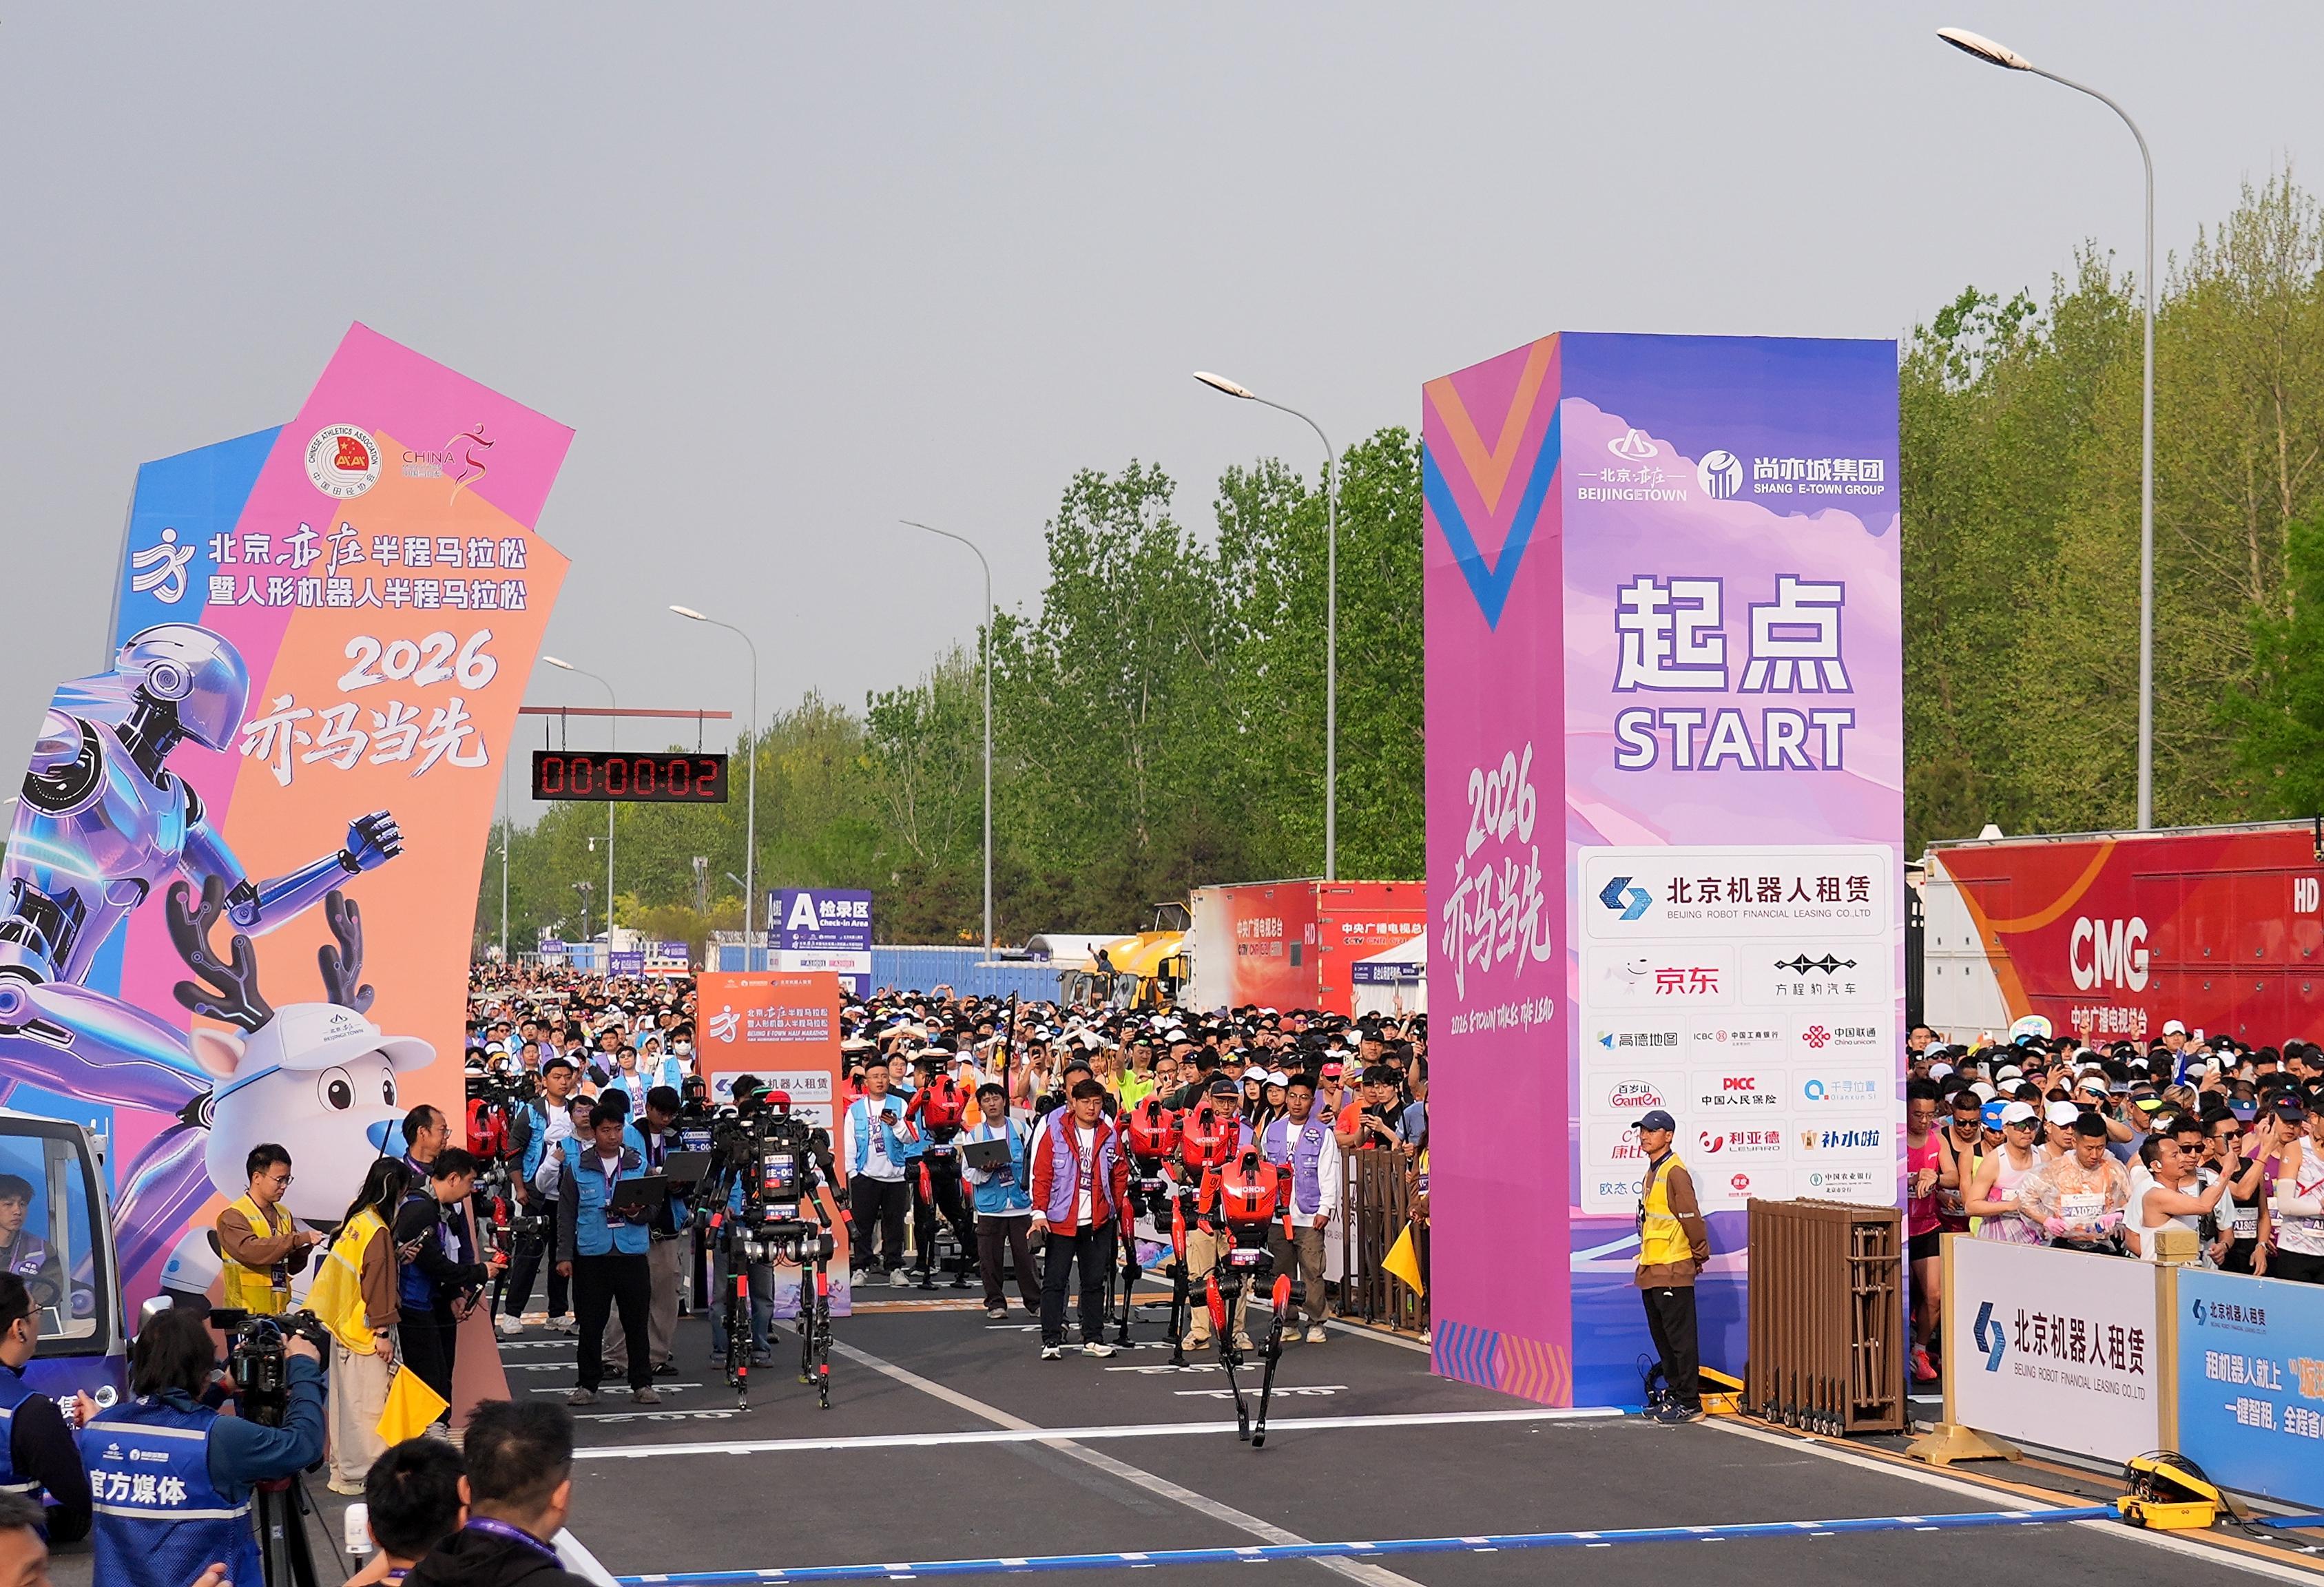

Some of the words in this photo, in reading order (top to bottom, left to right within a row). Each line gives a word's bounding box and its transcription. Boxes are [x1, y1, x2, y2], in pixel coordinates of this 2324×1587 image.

[321, 427, 353, 440] ATHLETICS
[354, 431, 379, 465] ASSOCIATION
[402, 451, 455, 463] CHINA
[1753, 457, 1885, 483] 尚亦城集团
[1577, 488, 1687, 502] BEIJINGETOWN
[1753, 484, 1794, 495] SHANG
[1798, 484, 1842, 495] E-TOWN
[1845, 484, 1885, 495] GROUP
[208, 577, 527, 610] 暨人形机器人半程马拉松
[1612, 574, 1854, 694] 起点
[337, 628, 497, 692] 2026
[238, 692, 490, 787] 亦马当先
[1614, 707, 1855, 771] START
[541, 757, 718, 797] 00:00:02
[1465, 741, 1537, 859] 2026
[1666, 875, 1871, 904] 北京机器人租赁
[2294, 876, 2320, 913] HD
[786, 893, 820, 931] A
[819, 900, 869, 918] 检录区
[1667, 910, 1702, 919] BEIJING
[1707, 909, 1739, 919] ROBOT
[1743, 909, 1789, 918] FINANCIAL
[1794, 909, 1832, 918] LEASING
[851, 919, 869, 927] Area
[1442, 845, 1551, 1002] 亦马当先
[1304, 923, 1316, 945] HD
[2070, 916, 2150, 993] CMG
[1654, 967, 1720, 995] 京东
[1776, 982, 1857, 996] 方程豹汽车
[1619, 1032, 1678, 1047] 高德地图
[1731, 1031, 1778, 1039] 中国工商银行
[1834, 1026, 1876, 1038] 中国联通
[762, 1077, 829, 1090] 机器人租赁
[1619, 1085, 1650, 1094] 百岁山
[1723, 1077, 1755, 1090] PICC
[1831, 1080, 1876, 1093] 千寻位置
[1701, 1094, 1777, 1106] 中国人民保险
[1729, 1130, 1780, 1145] 利亚德
[1821, 1130, 1880, 1148] 补水啦
[1612, 1145, 1648, 1159] 康比
[1825, 1172, 1872, 1181] 中国农业银行
[1599, 1182, 1628, 1196] 欧态
[2015, 1308, 2146, 1376] 北京机器人租赁
[2014, 1362, 2036, 1377] BEIJING
[2037, 1367, 2059, 1384] ROBOT
[2060, 1371, 2092, 1391] FINANCIAL
[2093, 1376, 2120, 1396] LEASING
[2206, 1349, 2282, 1391] 租机器人就上
[90, 1469, 187, 1506] 官方媒体
